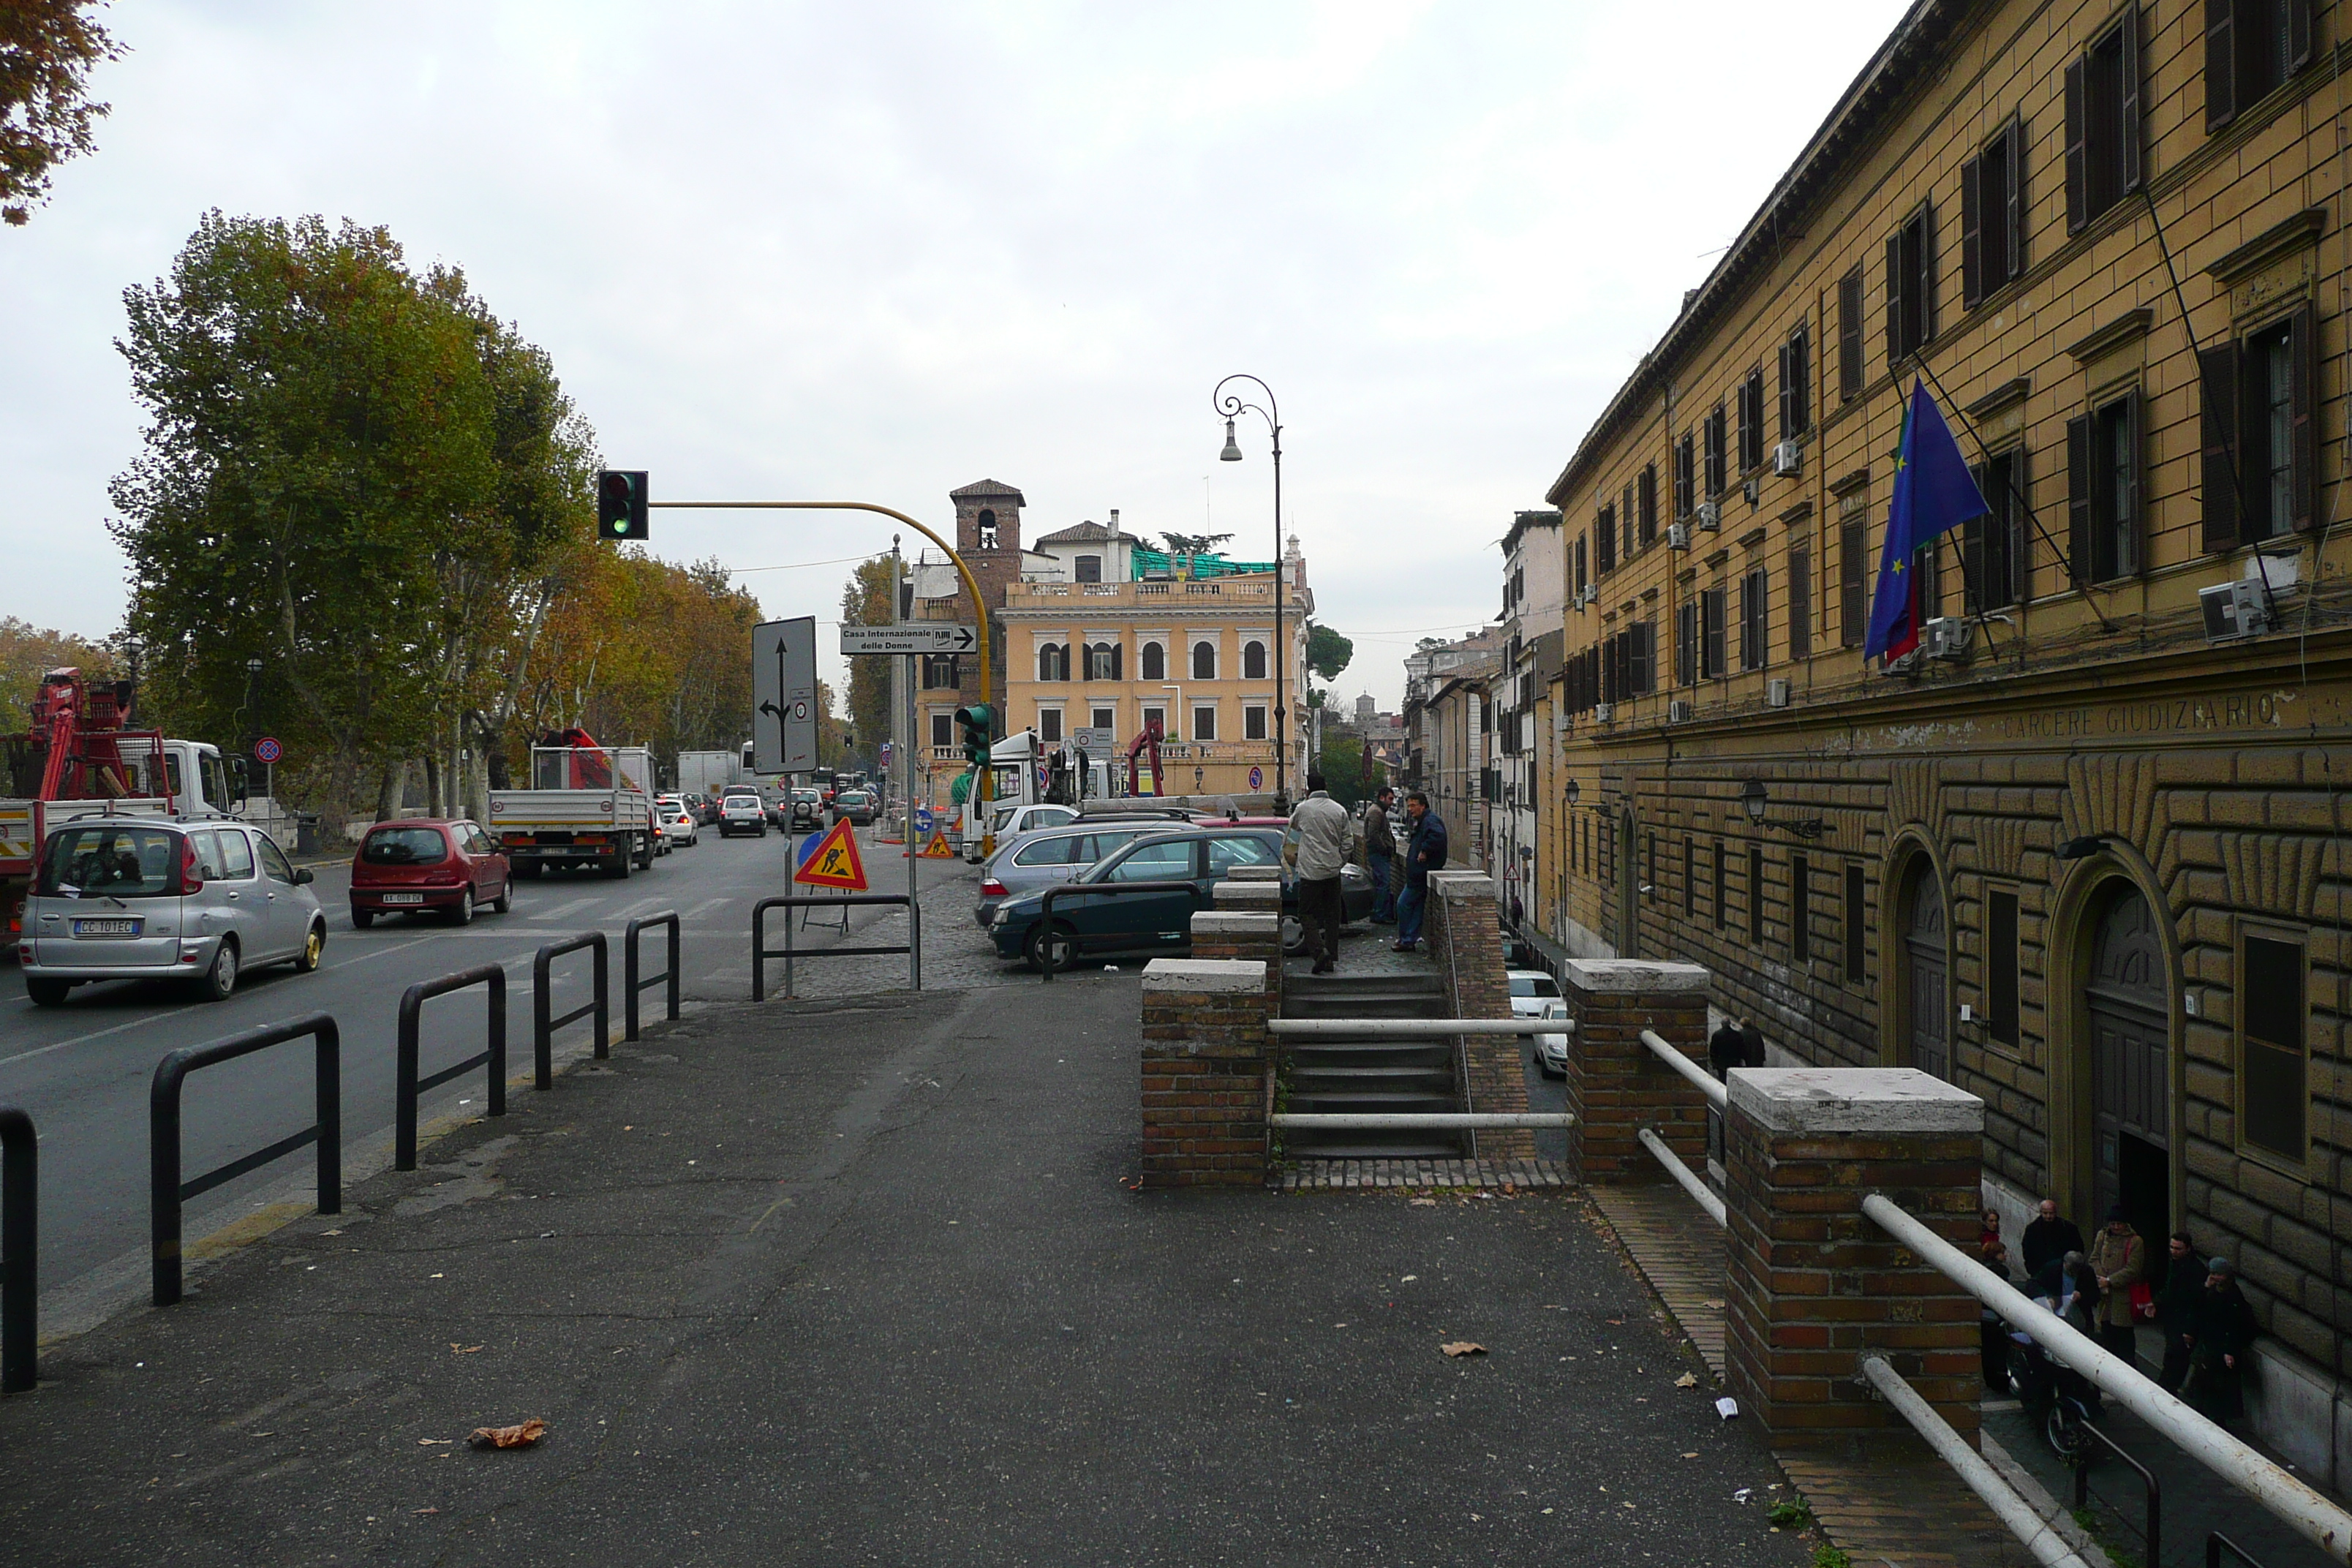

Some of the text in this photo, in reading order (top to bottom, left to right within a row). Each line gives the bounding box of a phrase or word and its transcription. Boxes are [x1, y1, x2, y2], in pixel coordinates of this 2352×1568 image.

[2004, 693, 2274, 739] CARCERE GIUDIZIARIO
[82, 921, 96, 932] CC
